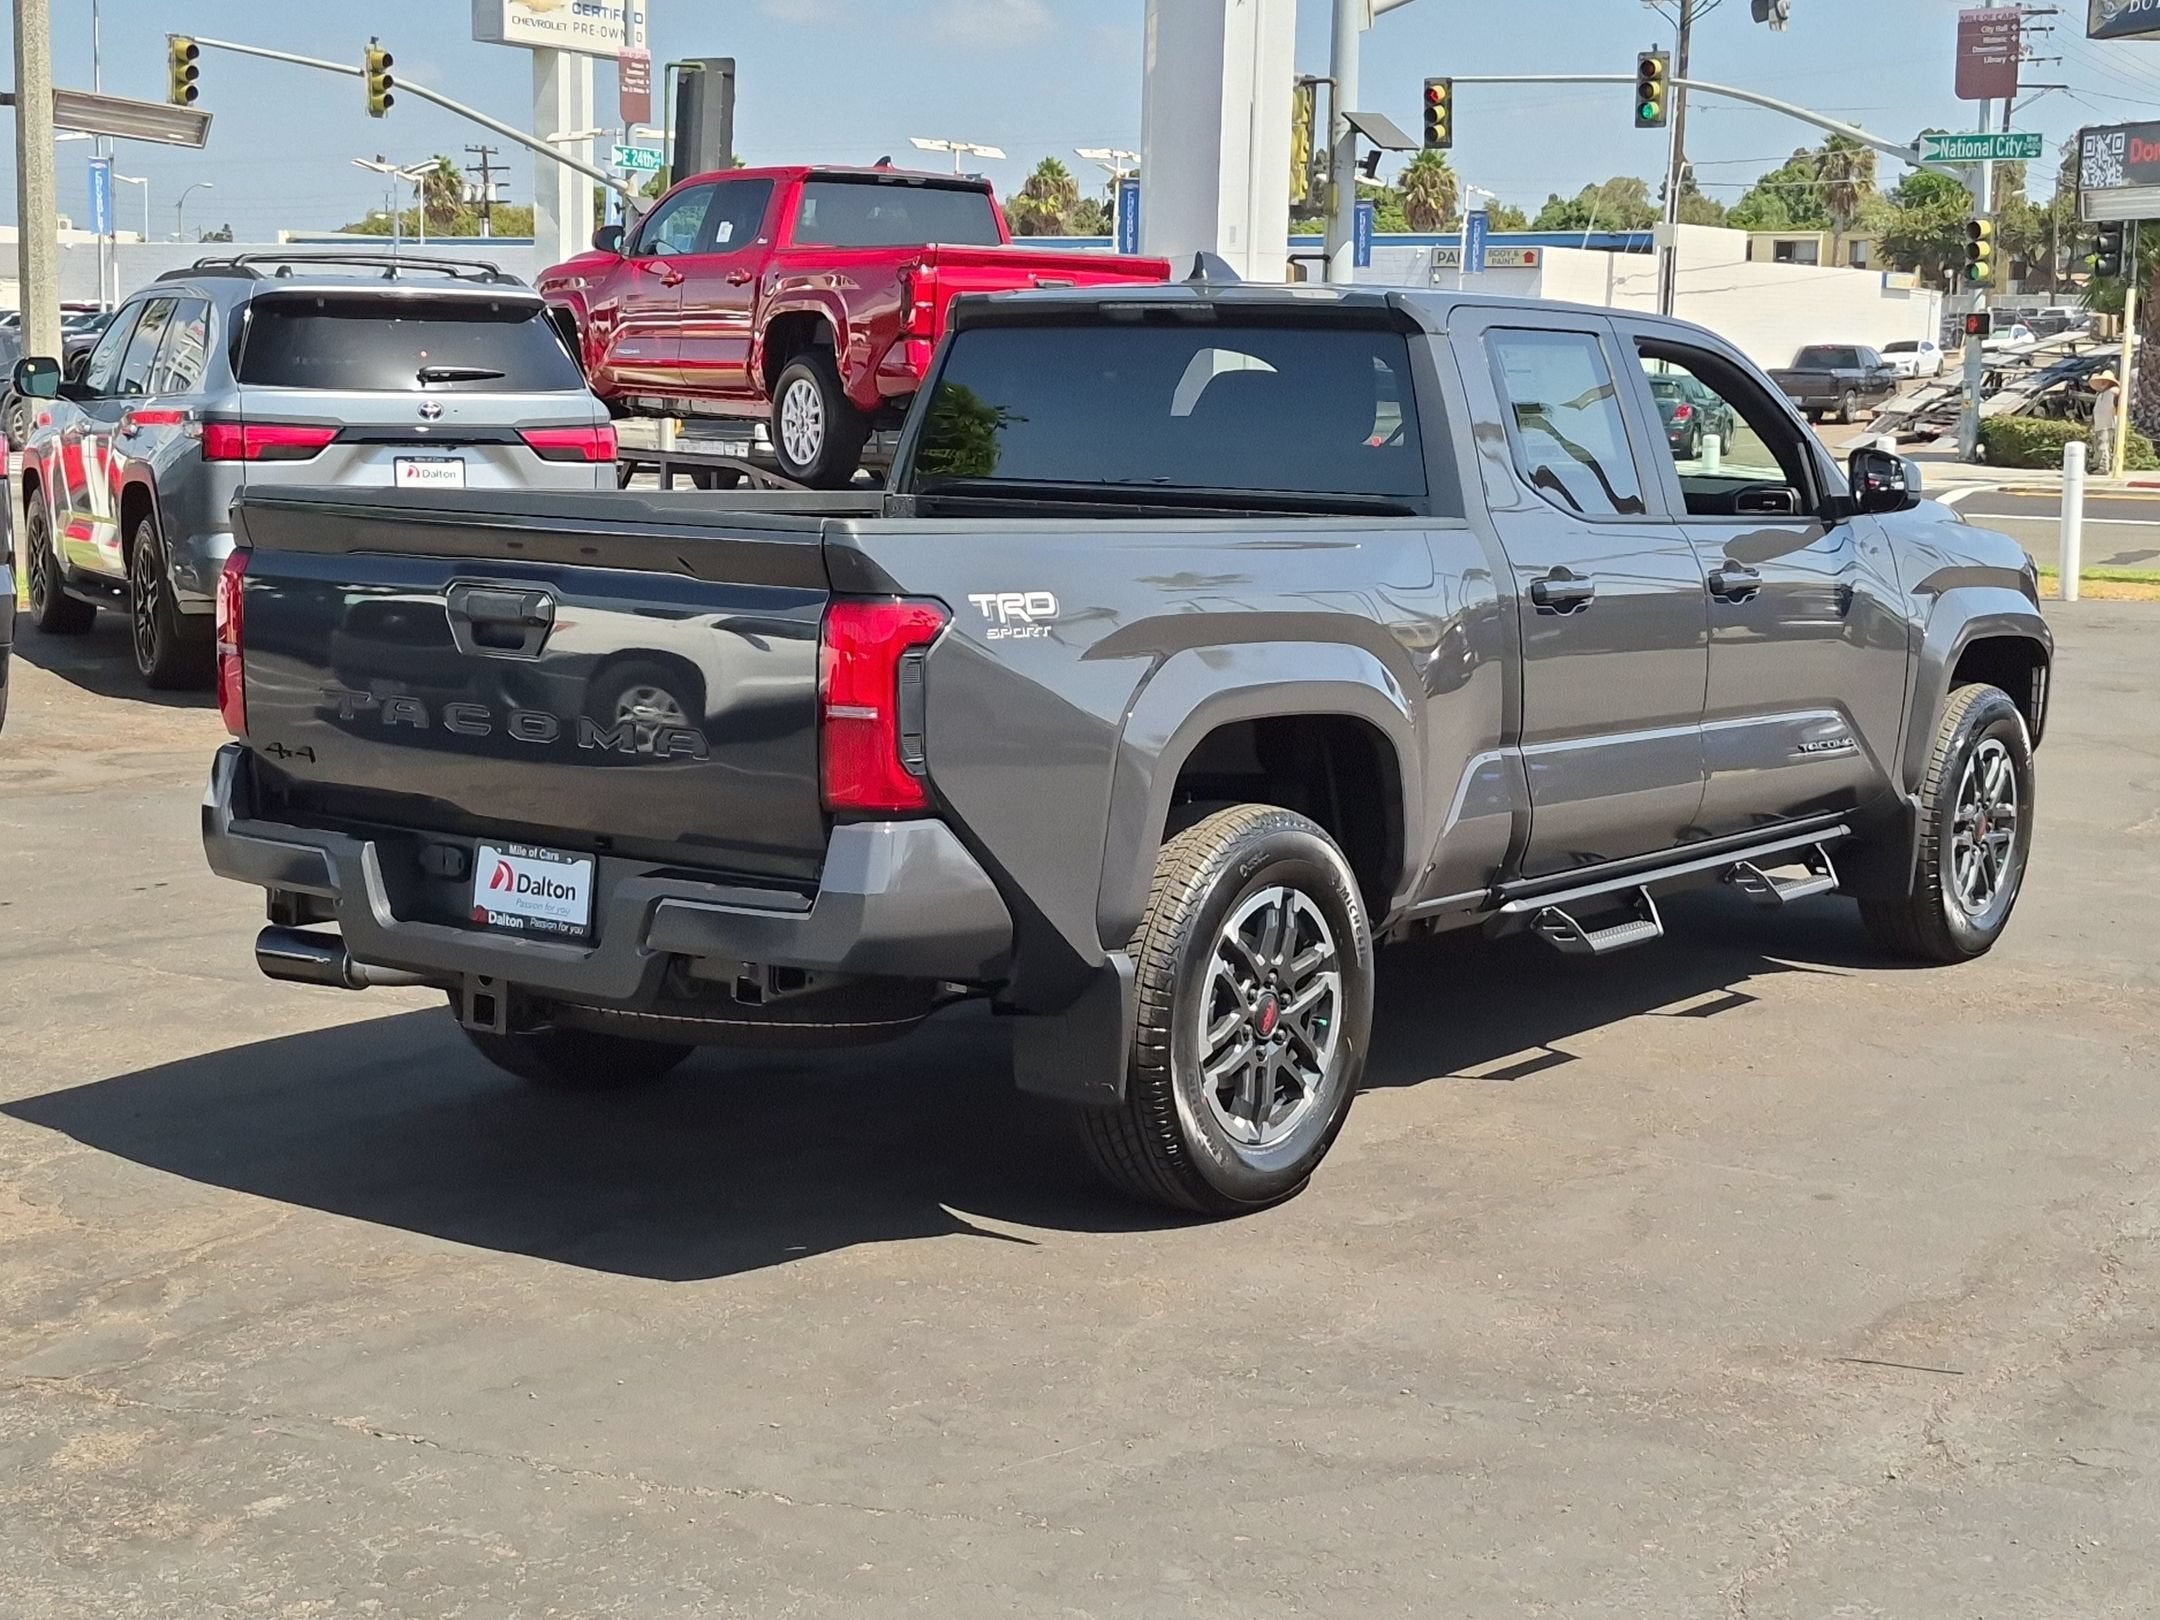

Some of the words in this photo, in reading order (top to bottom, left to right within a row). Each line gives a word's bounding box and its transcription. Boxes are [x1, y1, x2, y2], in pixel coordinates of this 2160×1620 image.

[511, 16, 568, 31] CHEVROLET
[572, 2, 644, 25] CERTIFD
[573, 21, 643, 43] PRE-OWND
[622, 148, 632, 166] E
[631, 149, 655, 168] 24th
[1940, 137, 1994, 159] National
[1996, 136, 2023, 158] City
[422, 468, 456, 479] Dalton
[967, 591, 1060, 626] TRD
[986, 625, 1053, 640] SPORT
[320, 688, 711, 761] TACOMA
[1797, 736, 1854, 753] TACOMA
[509, 844, 527, 857] Mile
[528, 848, 539, 858] of
[539, 849, 560, 861] Cars
[516, 873, 576, 901] Dalton
[515, 898, 543, 910] Passion
[543, 902, 556, 912] for
[556, 904, 571, 916] you
[488, 911, 524, 929] Dalton
[529, 917, 557, 930] Passion
[558, 921, 569, 932] for
[569, 924, 584, 936] you
